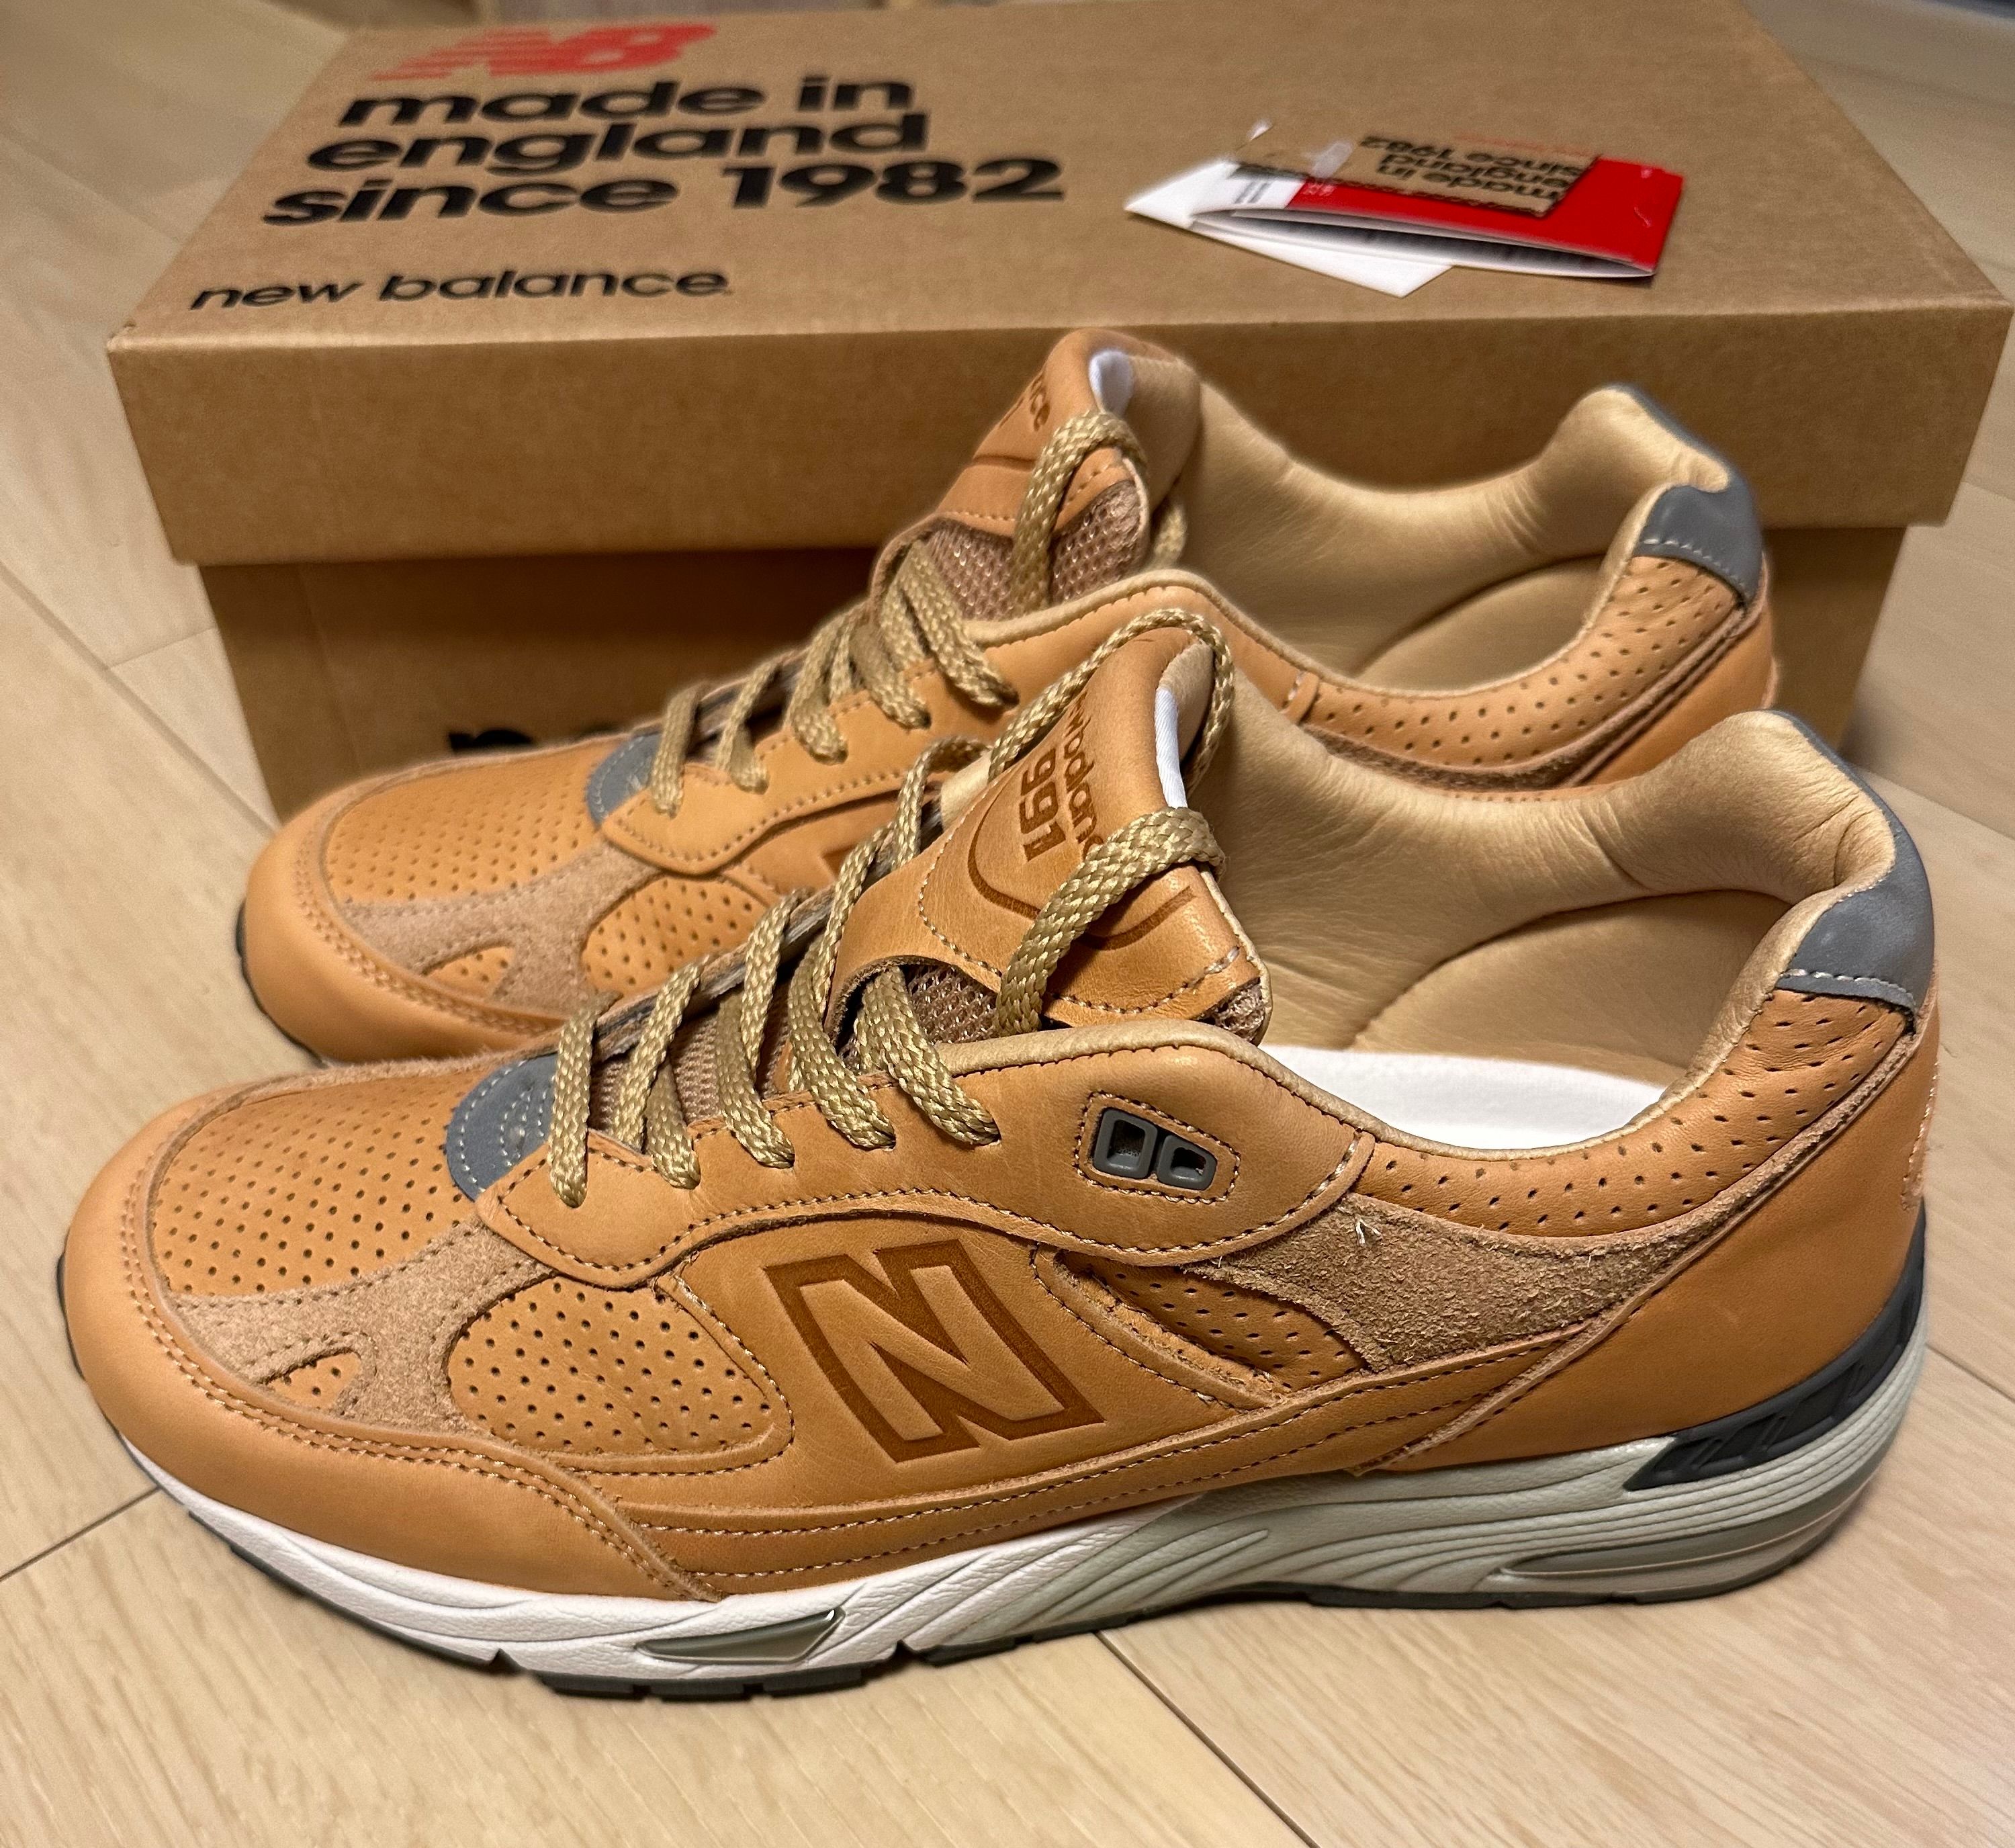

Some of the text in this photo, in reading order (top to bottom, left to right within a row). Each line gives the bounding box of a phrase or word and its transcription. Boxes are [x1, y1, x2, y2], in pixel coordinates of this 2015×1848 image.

[338, 75, 914, 126] made in
[307, 112, 930, 177] england
[1359, 135, 1454, 160] 1982
[1379, 152, 1573, 187] england
[1466, 152, 1585, 177] since
[262, 157, 1066, 226] since 1982
[1376, 165, 1565, 200] made in
[190, 270, 729, 311] new balance
[1018, 747, 1067, 862] 991
[1063, 716, 1105, 862] balanc
[764, 1239, 1106, 1463] N
